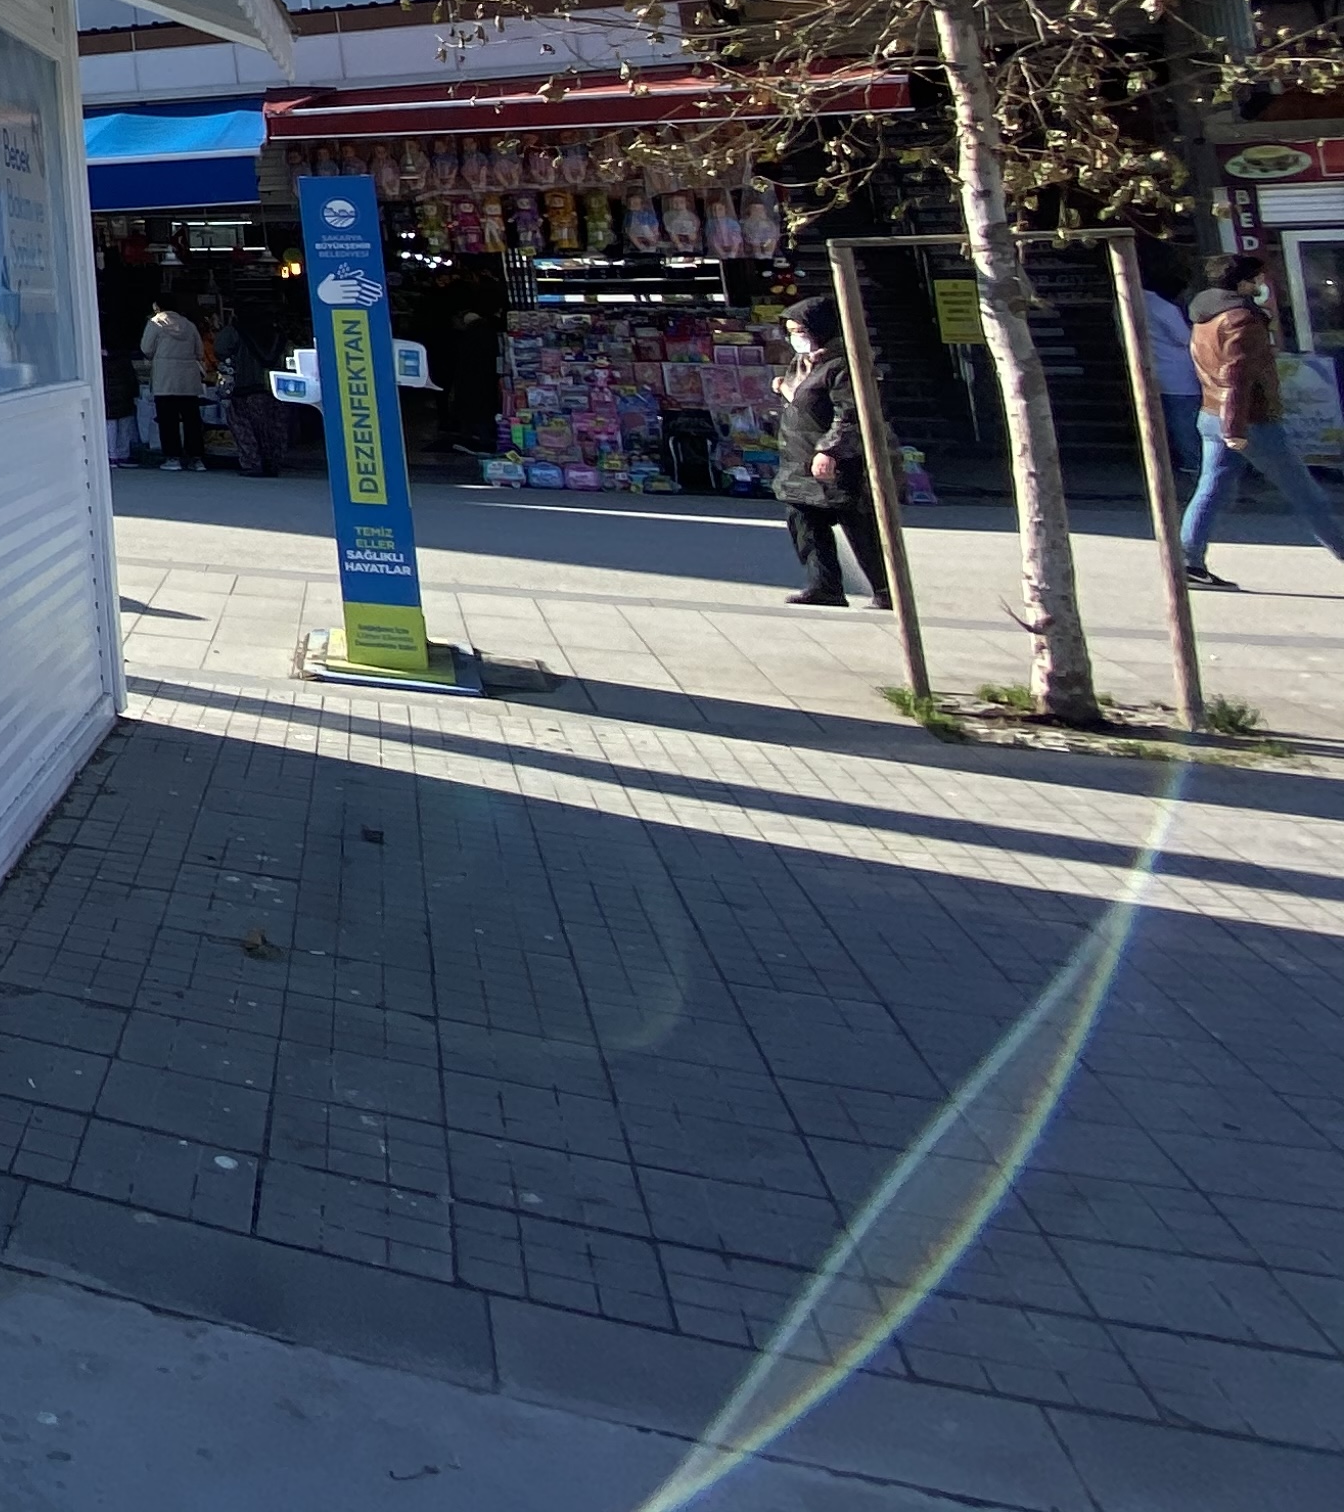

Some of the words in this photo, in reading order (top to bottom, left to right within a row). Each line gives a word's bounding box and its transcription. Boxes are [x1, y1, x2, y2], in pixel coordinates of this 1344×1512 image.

[341, 319, 379, 494] DEZENFEKTAN
[346, 549, 405, 563] SAĞLIKLI
[344, 562, 413, 577] HAYATLAR
